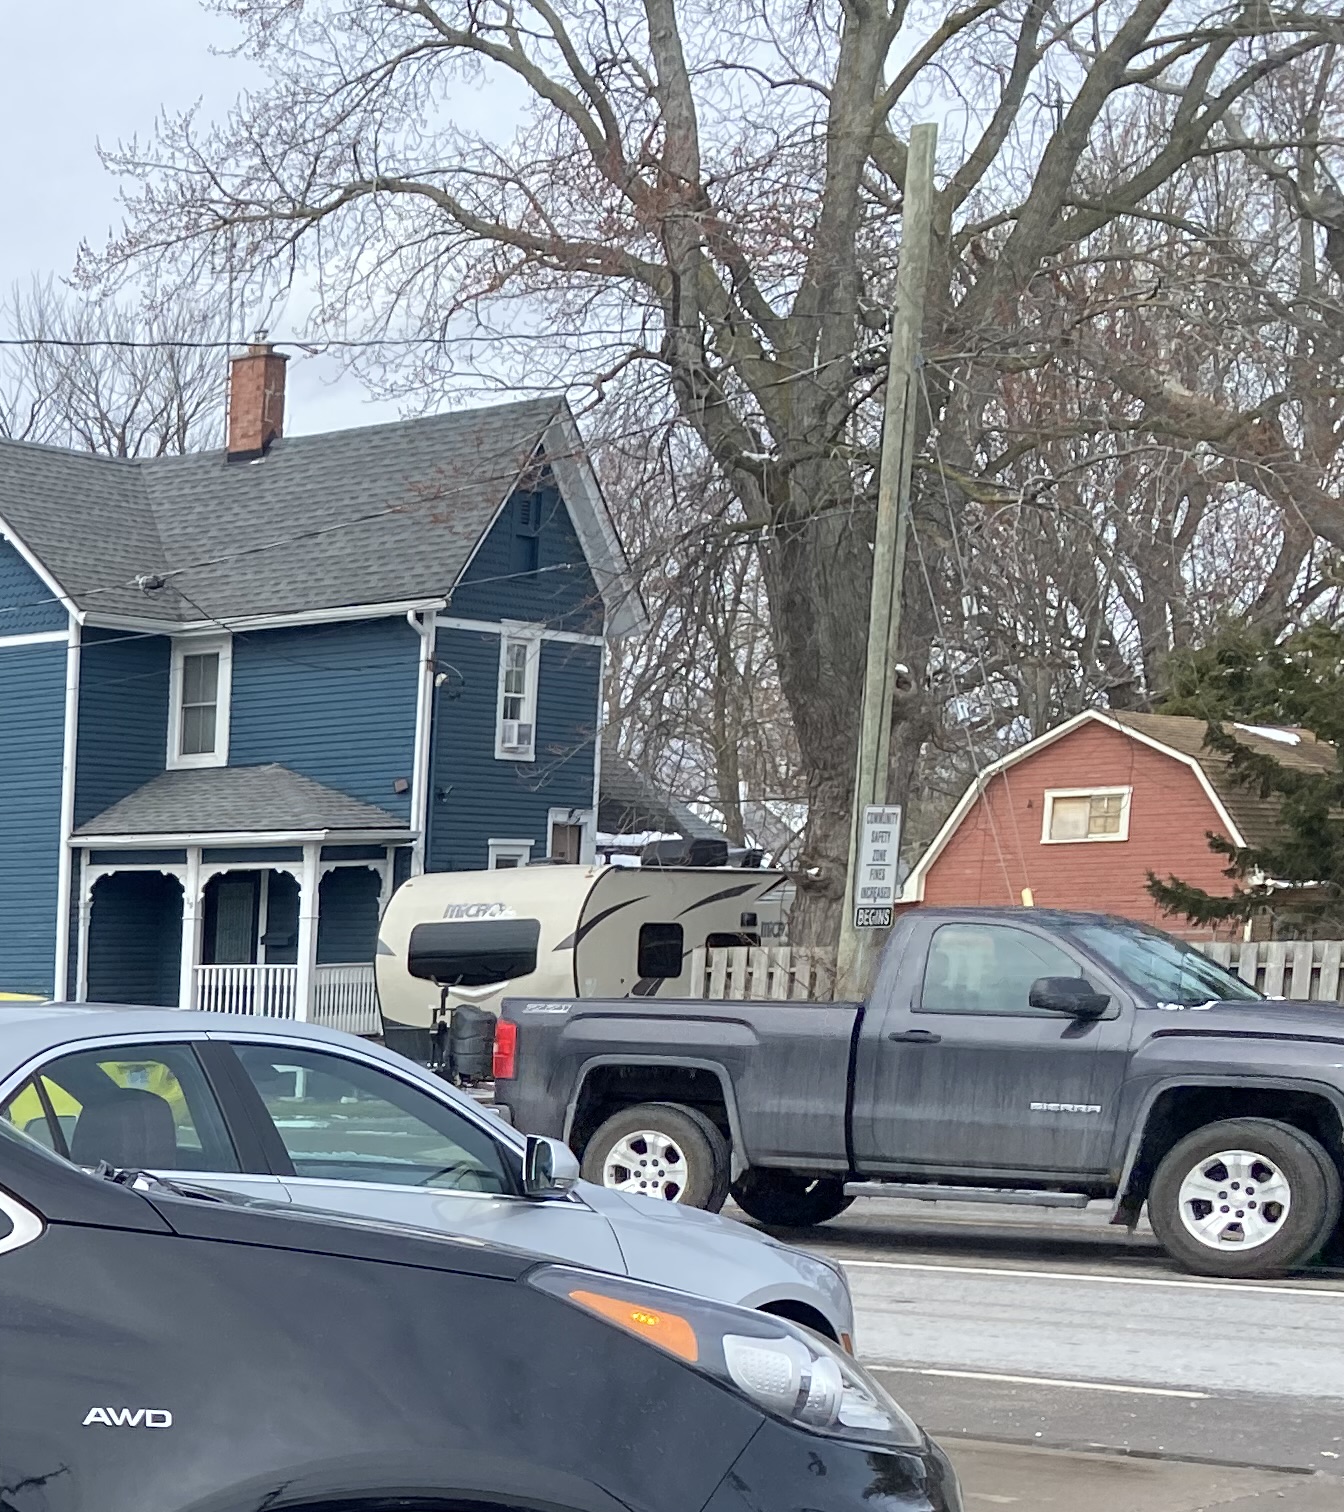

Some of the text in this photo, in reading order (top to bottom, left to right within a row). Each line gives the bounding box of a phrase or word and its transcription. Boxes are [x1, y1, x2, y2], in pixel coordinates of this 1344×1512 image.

[871, 830, 891, 843] SAFETY
[872, 849, 887, 862] ZONE
[869, 868, 885, 881] FINES
[860, 886, 891, 899] INCREASED
[857, 908, 892, 926] BEGINS
[82, 1407, 172, 1428] AWD
